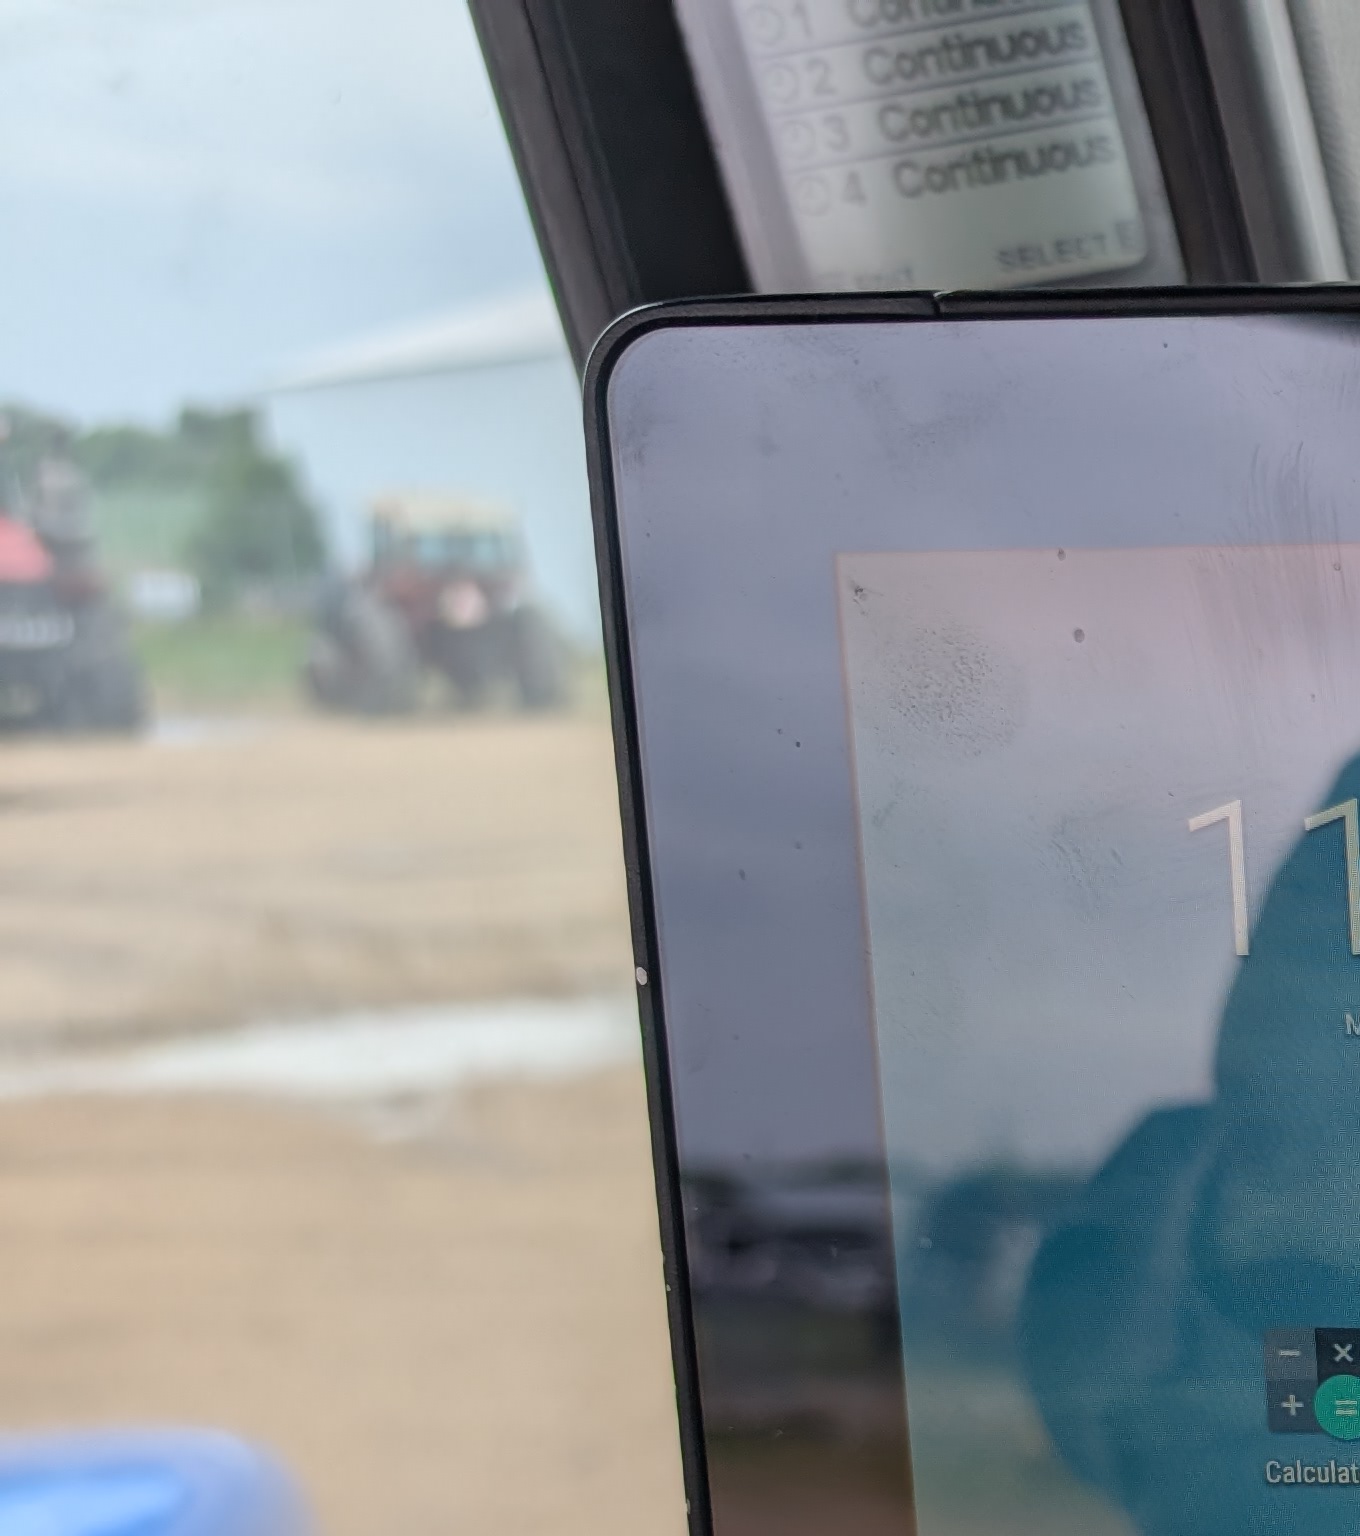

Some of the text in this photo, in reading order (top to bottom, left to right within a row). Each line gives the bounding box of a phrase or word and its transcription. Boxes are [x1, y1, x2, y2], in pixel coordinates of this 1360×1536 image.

[862, 20, 1094, 86] Continuous
[877, 77, 1105, 143] Continuous
[892, 134, 1118, 200] Continuous
